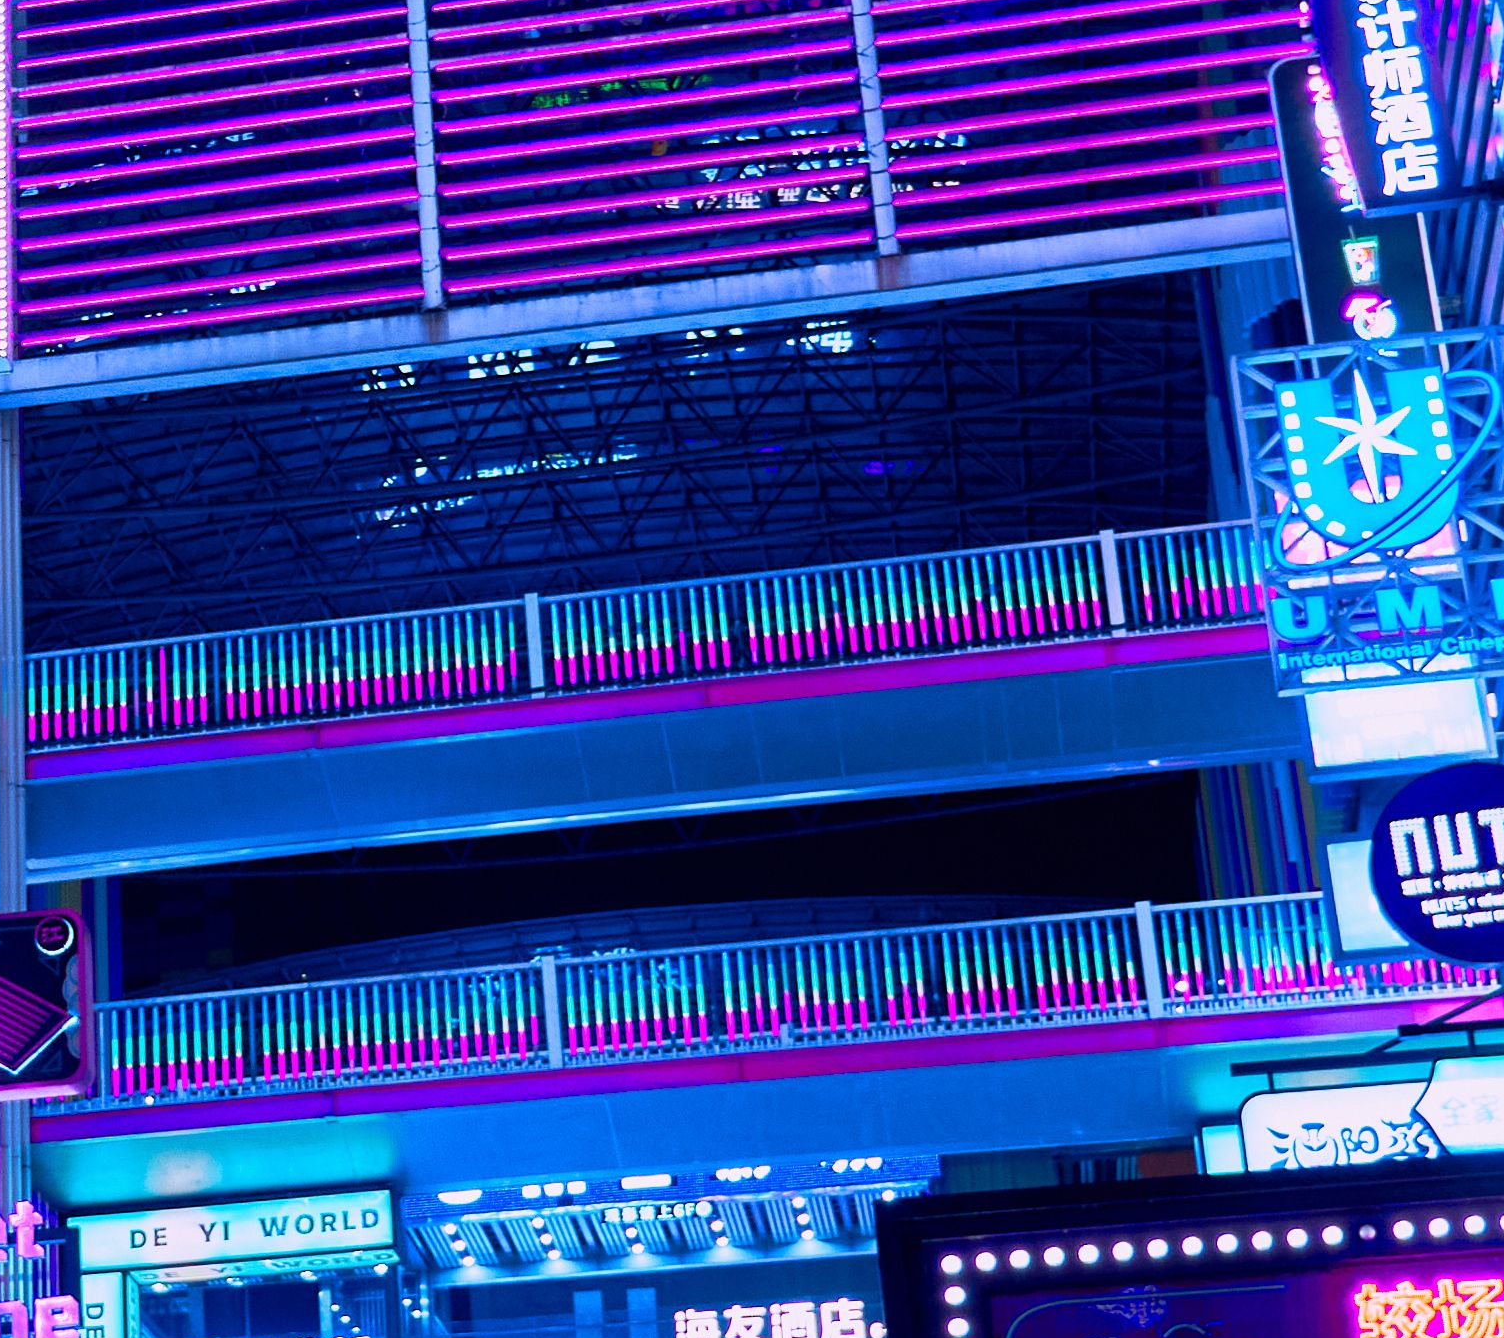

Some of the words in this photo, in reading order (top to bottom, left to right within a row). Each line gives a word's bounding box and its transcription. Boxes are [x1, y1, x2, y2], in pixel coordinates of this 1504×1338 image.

[1278, 640, 1433, 672] International
[130, 1227, 168, 1249] DE
[199, 1219, 231, 1243] YI
[259, 1207, 380, 1238] WORLD
